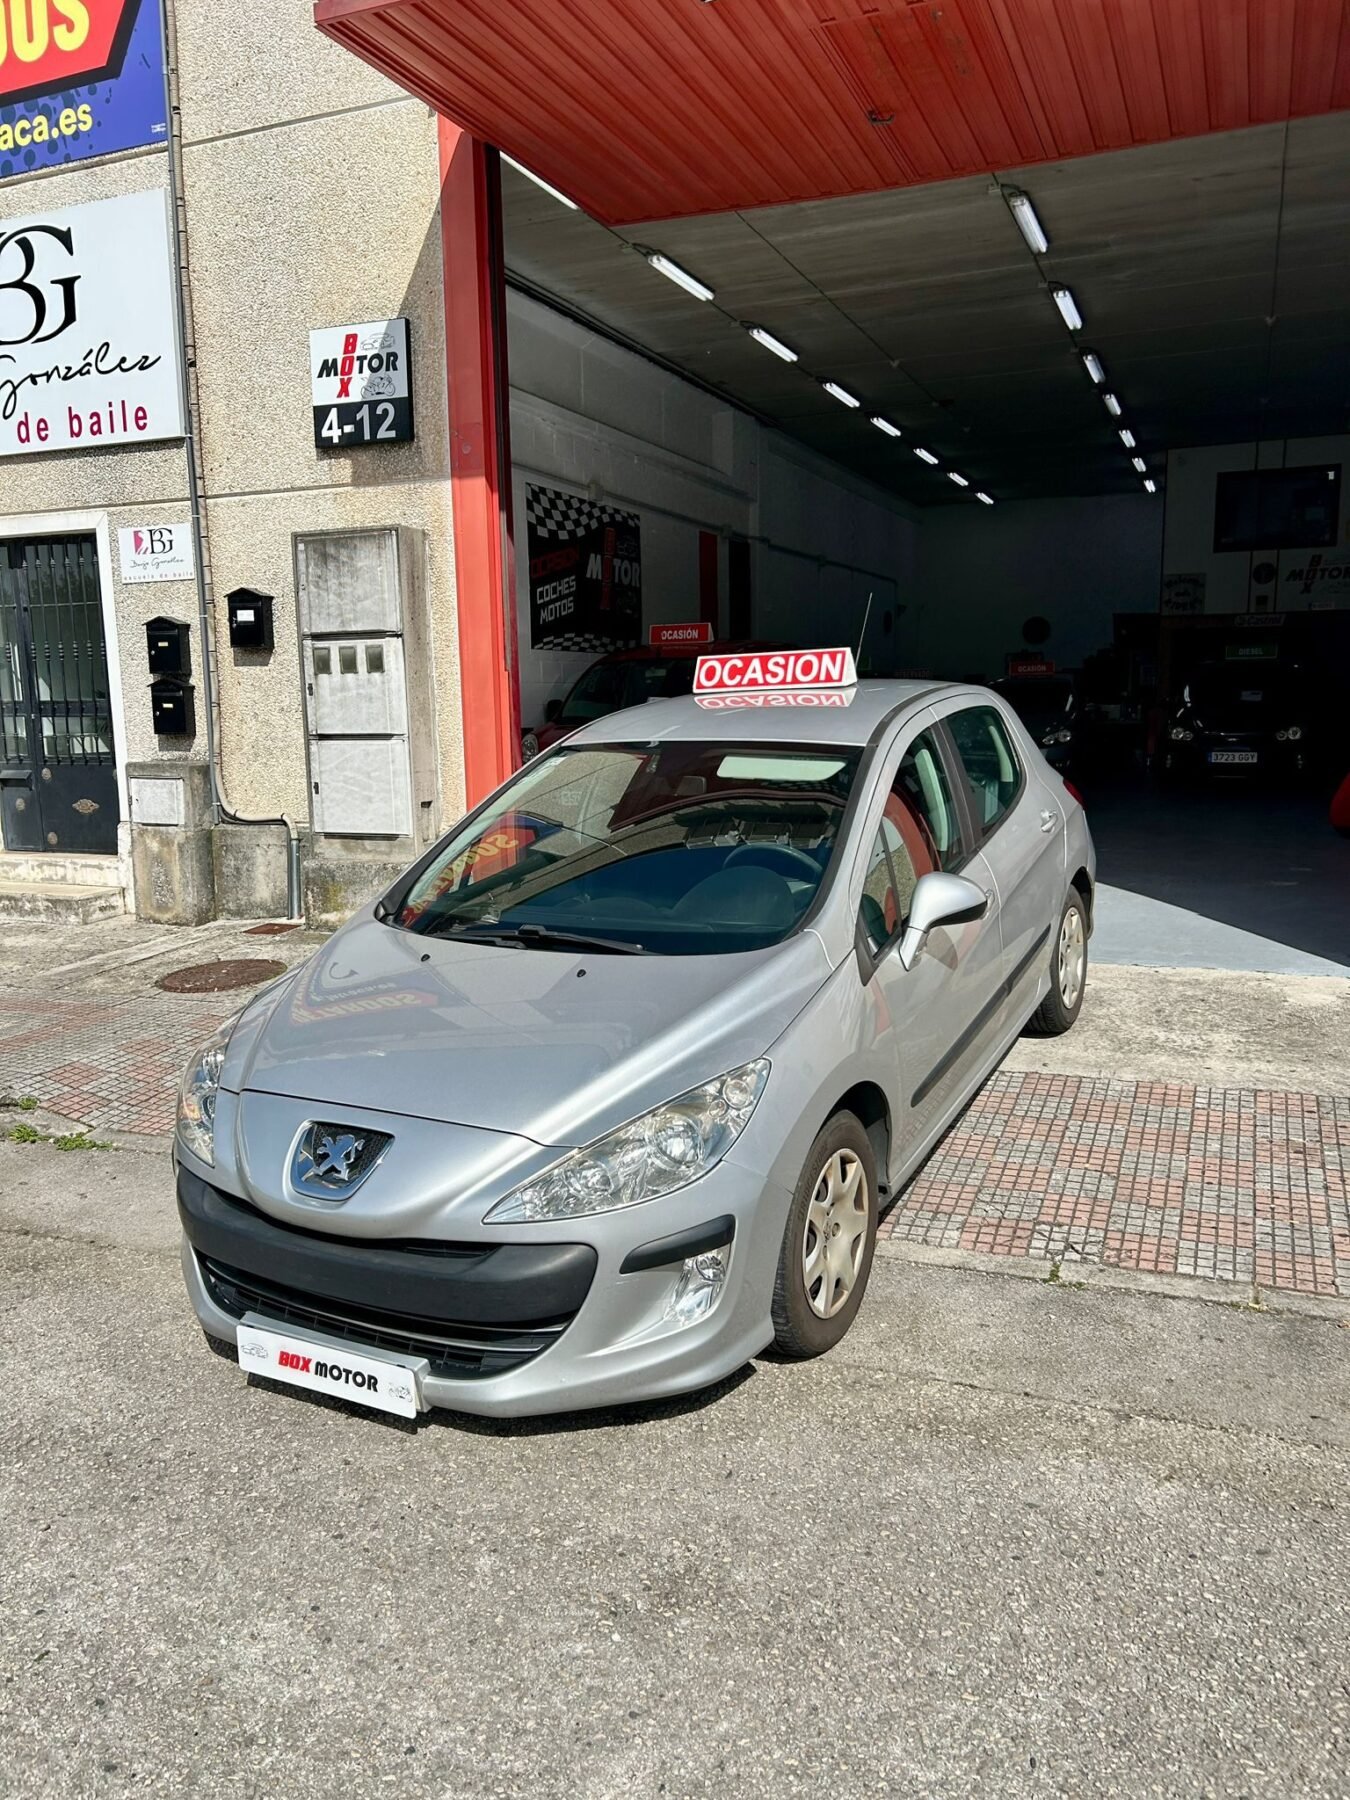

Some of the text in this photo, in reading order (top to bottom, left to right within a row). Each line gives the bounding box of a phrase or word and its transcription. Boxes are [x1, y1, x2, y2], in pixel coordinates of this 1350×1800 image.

[317, 351, 398, 378] MOTOR
[17, 400, 148, 443] de baile
[321, 401, 396, 443] 4-12
[537, 576, 576, 604] COCHES
[539, 597, 574, 624] MOTOS
[699, 653, 843, 688] OCASION
[278, 1351, 378, 1392] BOX MOTOR
